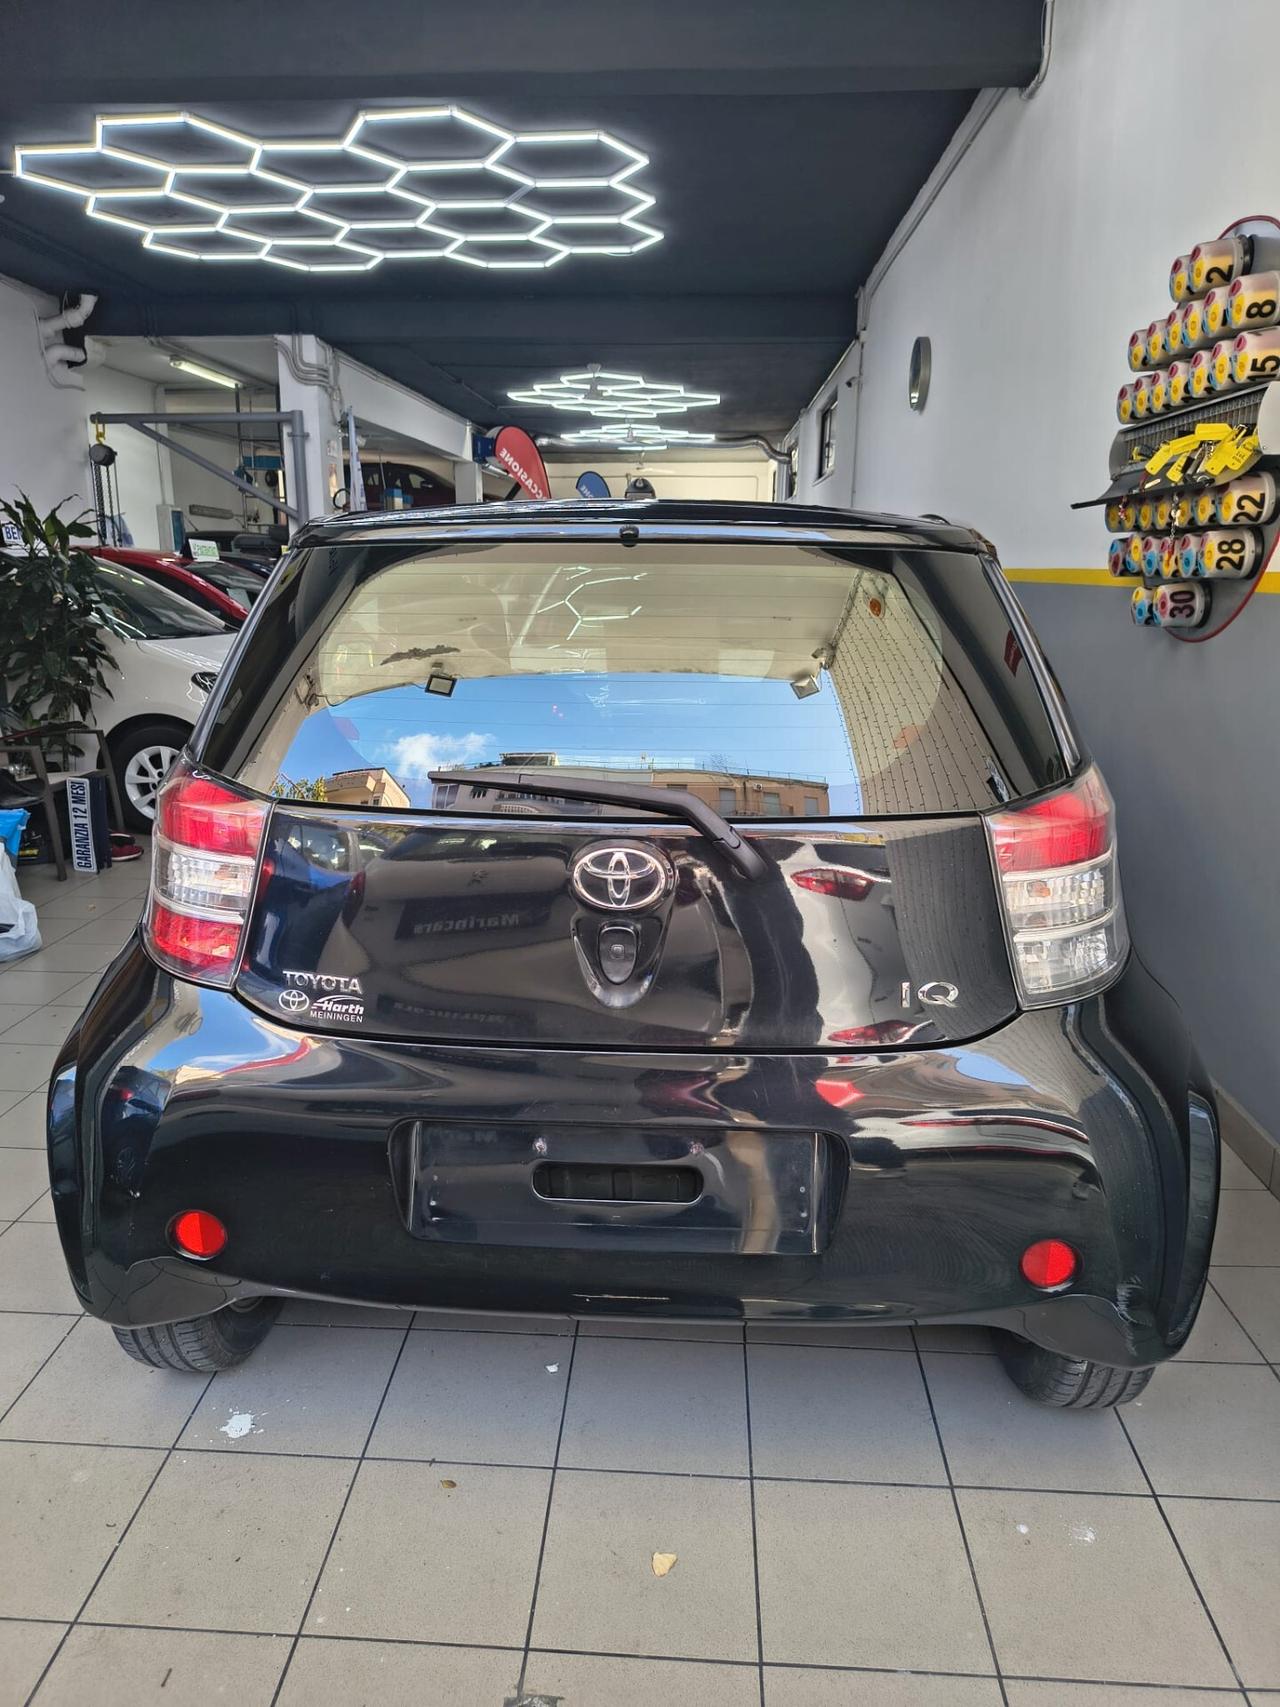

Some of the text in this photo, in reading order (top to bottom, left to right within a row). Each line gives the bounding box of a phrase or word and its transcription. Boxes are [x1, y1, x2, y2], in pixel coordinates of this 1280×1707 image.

[1205, 264, 1234, 284] 2
[1246, 298, 1276, 319] 8
[1247, 354, 1280, 380] 15
[1232, 492, 1265, 524] 22
[1216, 537, 1246, 571] 28
[1169, 590, 1195, 619] 30
[71, 781, 92, 868] GARANZIA 12 MESI
[282, 970, 363, 995] TOYOTA
[310, 1010, 363, 1023] MEININGEN
[321, 1000, 364, 1014] Harth
